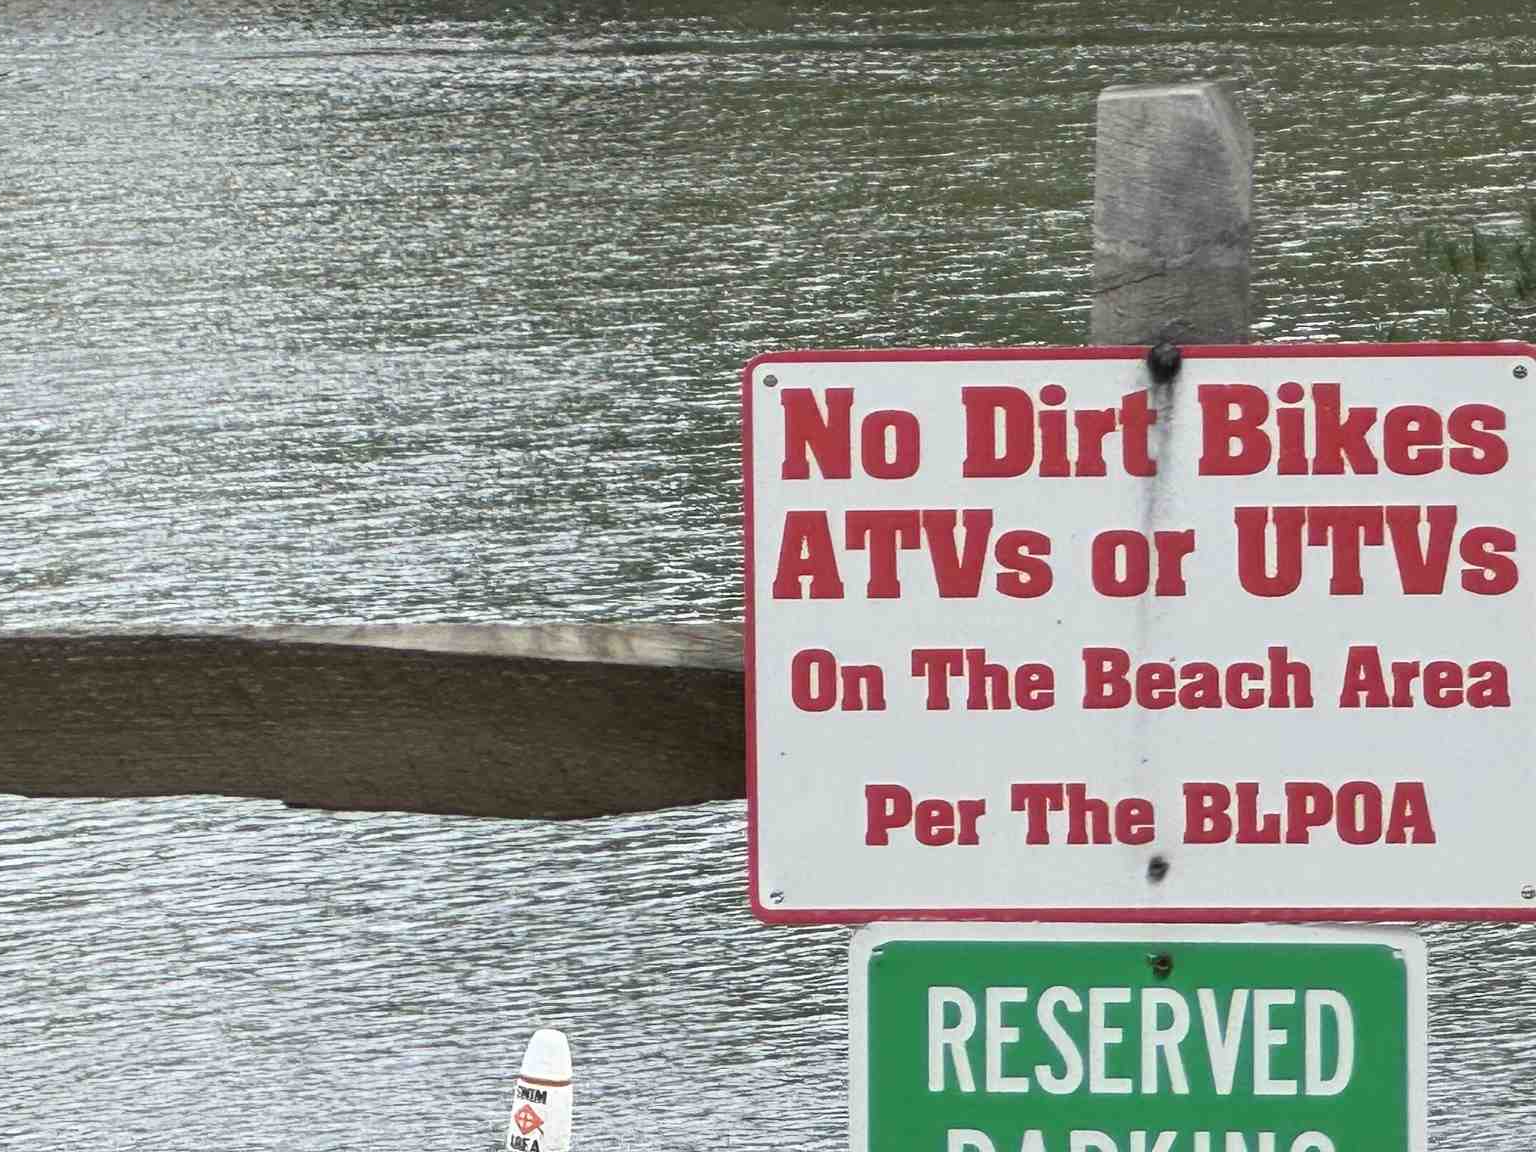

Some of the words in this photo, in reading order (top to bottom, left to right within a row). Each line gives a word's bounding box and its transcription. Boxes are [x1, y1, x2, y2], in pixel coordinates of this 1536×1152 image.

[780, 387, 921, 481] No
[960, 384, 1157, 479] Dirt
[1198, 383, 1508, 477] Bikes
[772, 510, 1053, 600] ATVs
[1091, 530, 1196, 598] or
[1235, 505, 1519, 598] UTVs
[791, 649, 885, 712] On
[911, 648, 1055, 711] The
[1082, 646, 1313, 711] Beach
[1338, 645, 1510, 709] Area
[864, 784, 986, 847] Per
[1011, 783, 1155, 846] The
[1183, 782, 1436, 846] BLPOA
[928, 985, 1354, 1097] RESERVED
